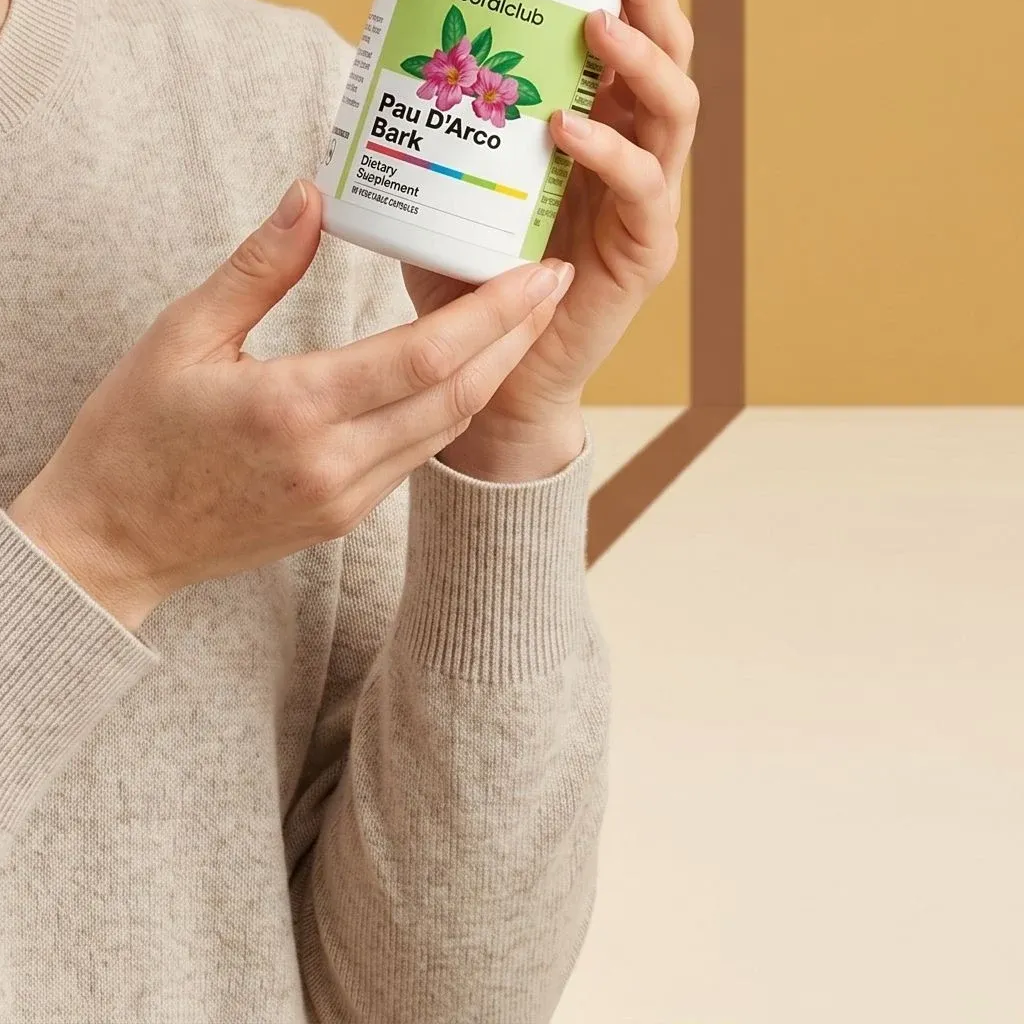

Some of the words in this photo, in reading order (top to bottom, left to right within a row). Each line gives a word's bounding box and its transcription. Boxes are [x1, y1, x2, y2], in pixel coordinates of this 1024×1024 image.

[371, 116, 424, 152] Bark
[378, 92, 421, 124] Pau
[425, 108, 501, 149] D'Arco
[361, 155, 397, 177] Dietary
